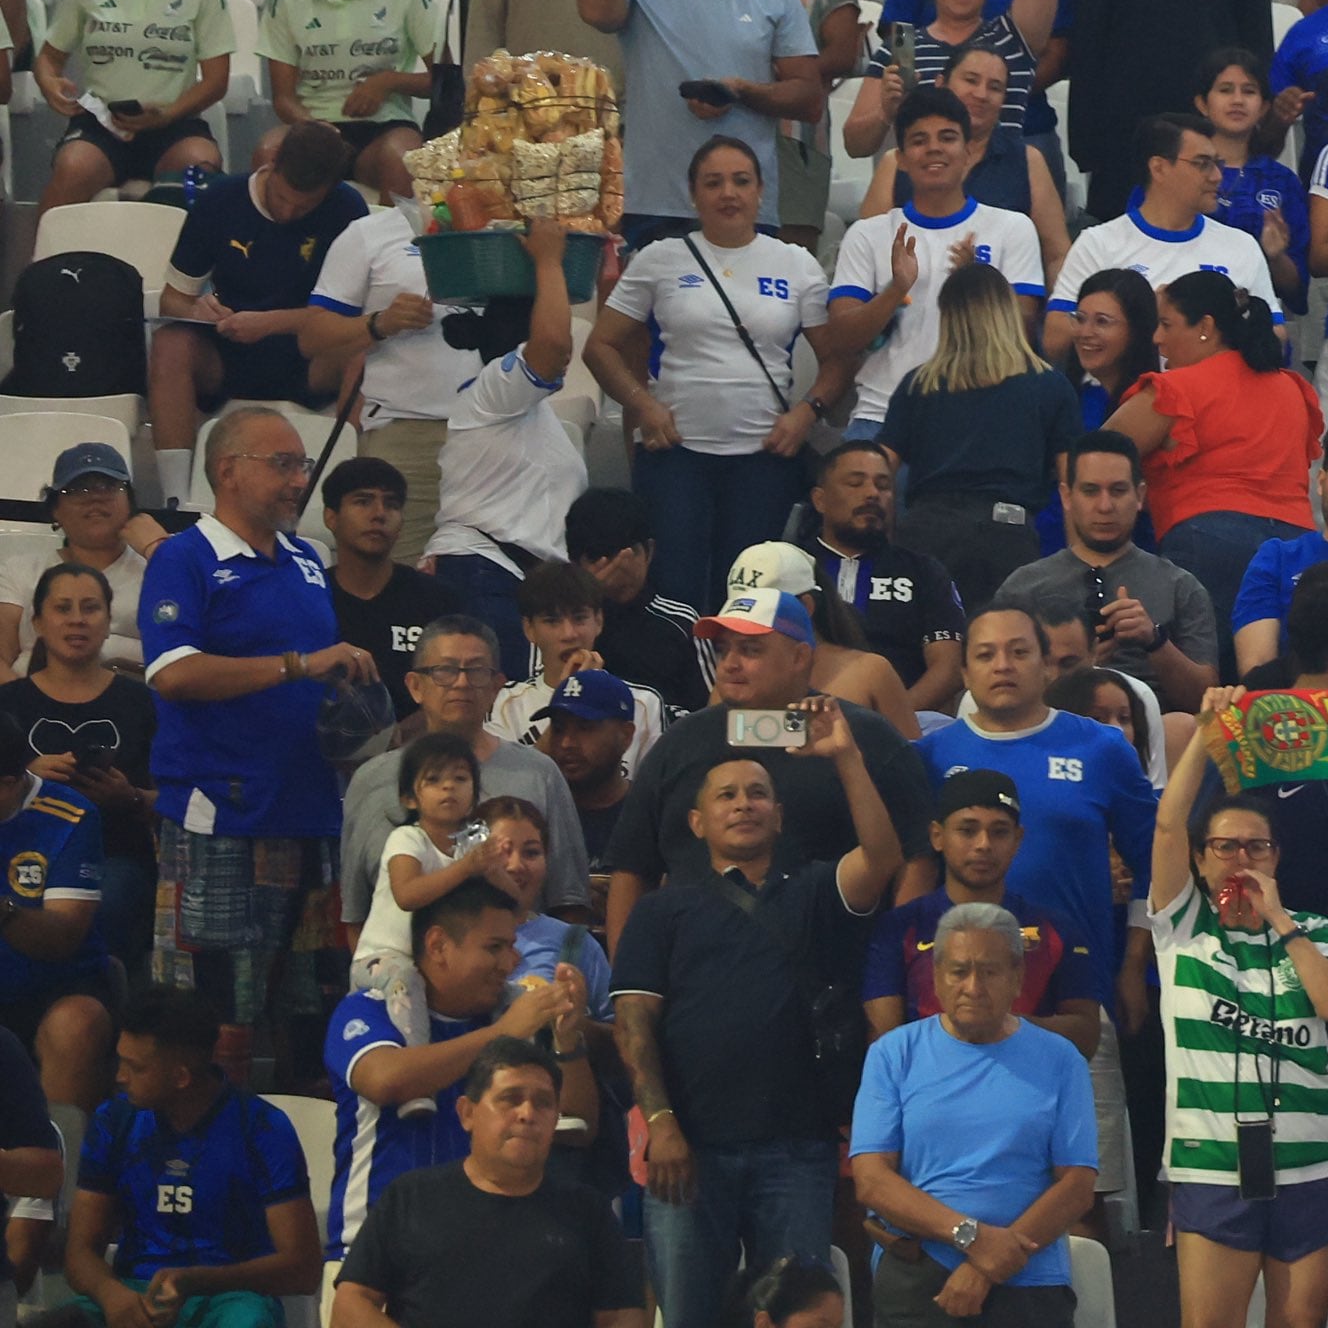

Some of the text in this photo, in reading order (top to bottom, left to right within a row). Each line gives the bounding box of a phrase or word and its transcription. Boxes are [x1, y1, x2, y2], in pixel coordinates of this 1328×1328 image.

[974, 244, 992, 265] S
[757, 276, 789, 300] ES
[292, 555, 327, 589] ES
[869, 576, 914, 602] ES
[391, 626, 424, 652] ES
[934, 629, 950, 641] ES
[1047, 756, 1083, 783] ES
[17, 864, 42, 885] ES
[1210, 998, 1311, 1047] Betano
[157, 1184, 193, 1213] ES
